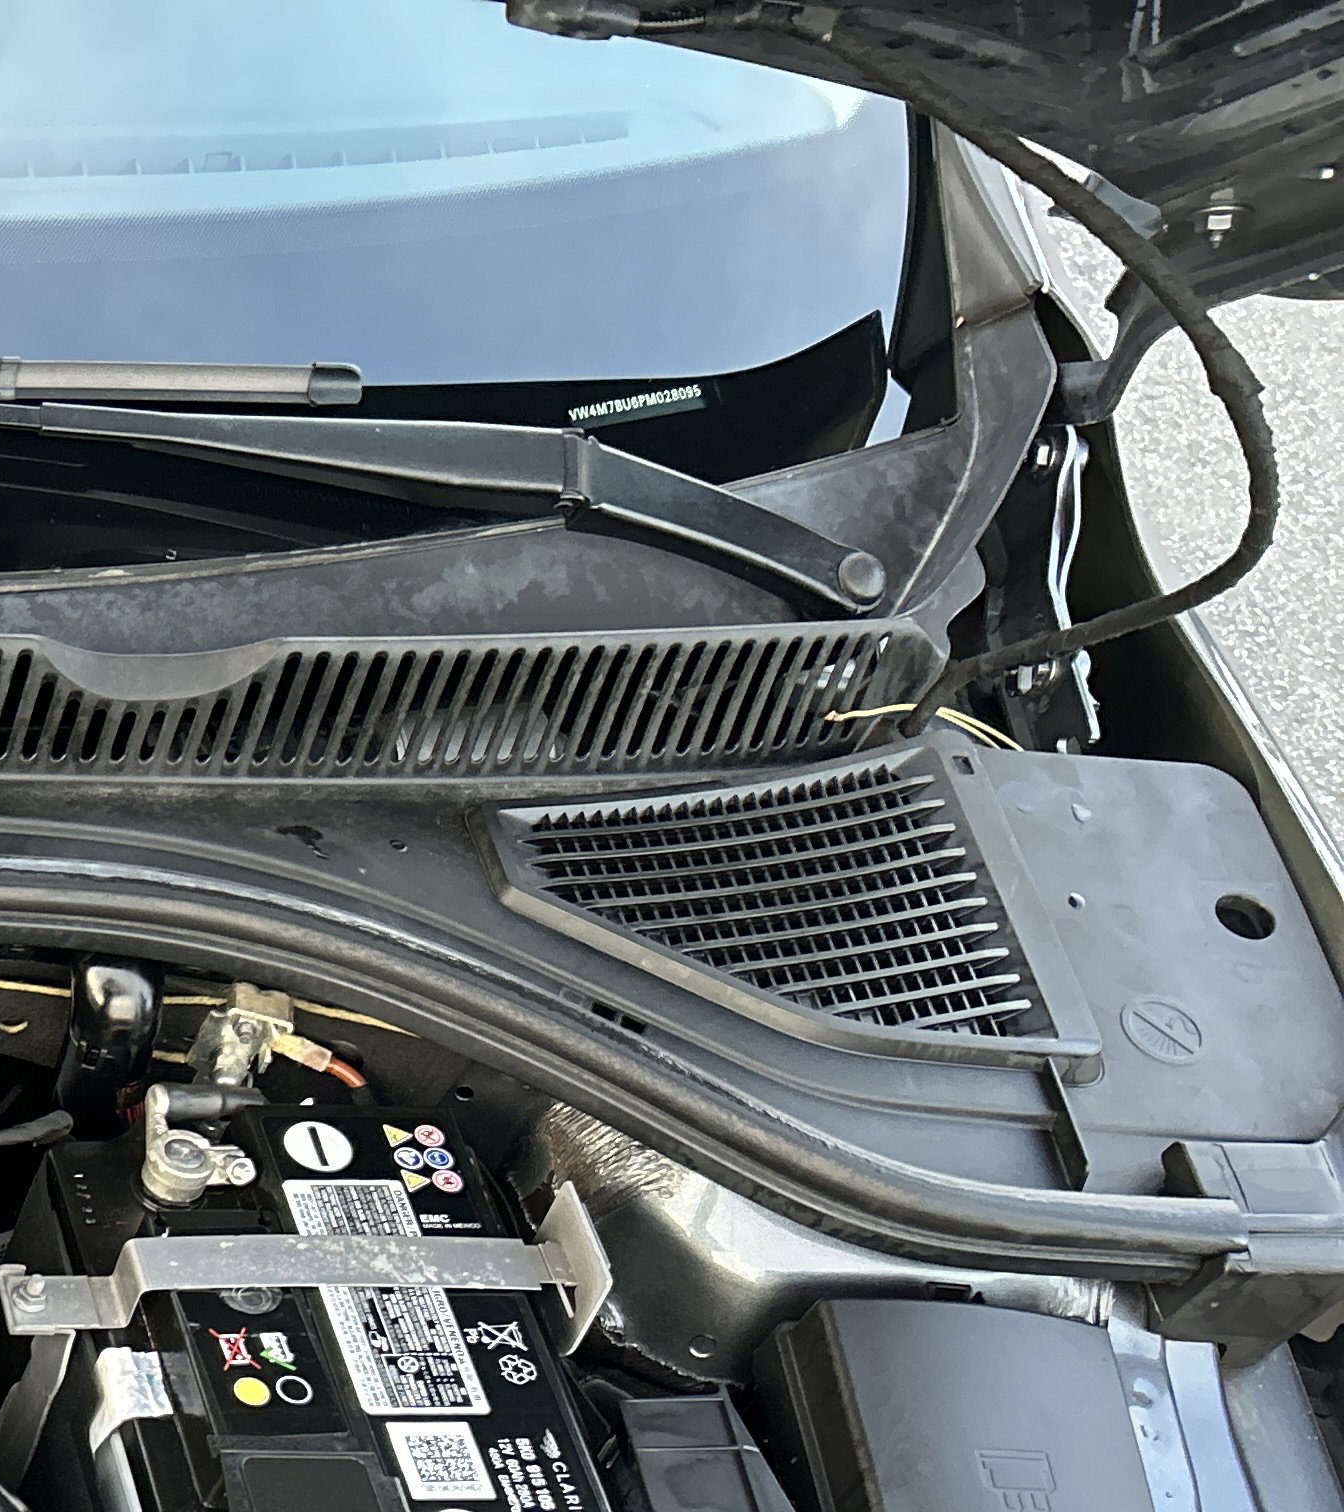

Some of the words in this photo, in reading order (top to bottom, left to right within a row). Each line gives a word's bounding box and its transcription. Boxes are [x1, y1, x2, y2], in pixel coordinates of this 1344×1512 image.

[393, 1190, 418, 1237] DANGER/P
[419, 1214, 450, 1223] EMC
[464, 1328, 480, 1344] Pb
[497, 1438, 515, 1455] 12V
[505, 1459, 525, 1482] 60Ah
[515, 1484, 536, 1508] 280A
